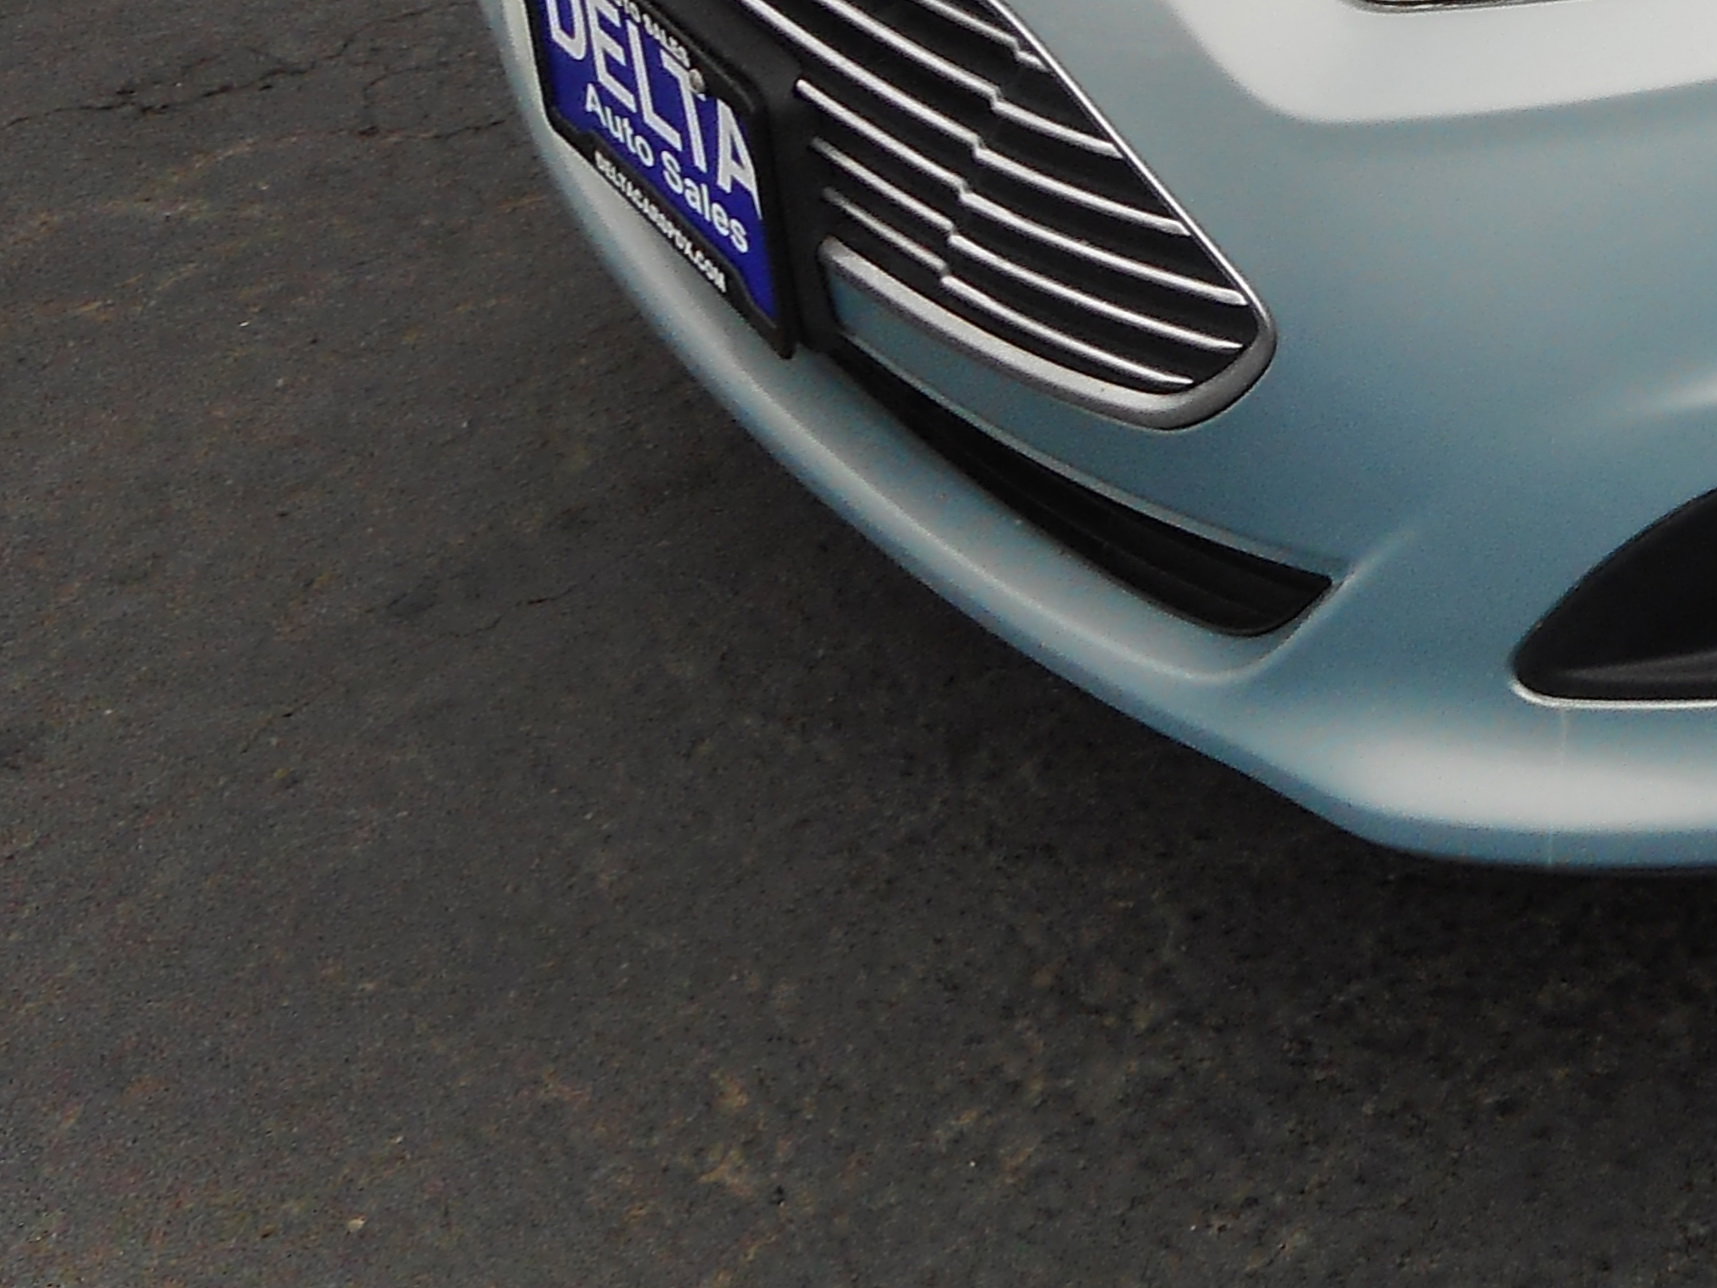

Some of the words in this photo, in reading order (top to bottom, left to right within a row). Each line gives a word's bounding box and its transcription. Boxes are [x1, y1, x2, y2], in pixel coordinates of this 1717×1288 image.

[642, 12, 691, 69] SALES
[584, 82, 655, 169] Auto
[661, 150, 750, 255] Sales
